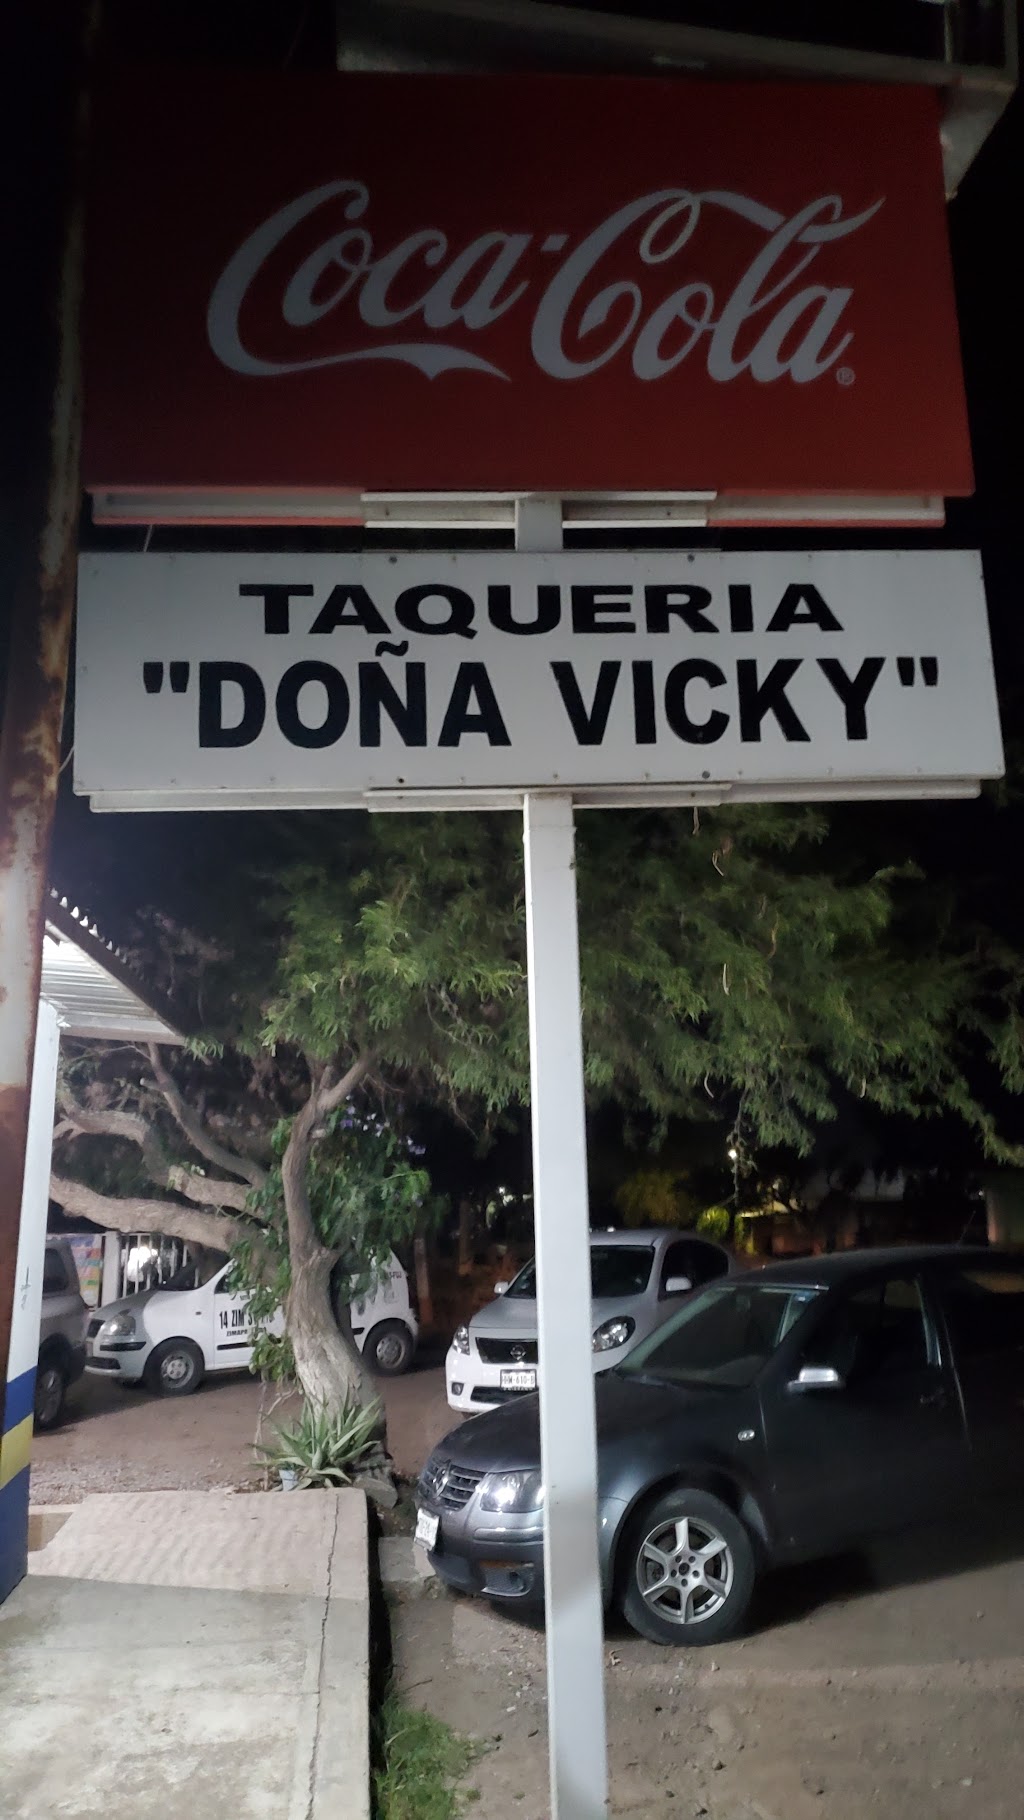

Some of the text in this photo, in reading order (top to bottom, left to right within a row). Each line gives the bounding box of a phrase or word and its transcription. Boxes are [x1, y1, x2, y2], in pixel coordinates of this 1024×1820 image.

[207, 179, 886, 383] Coca-Cola
[239, 582, 844, 640] TAQUERIA
[143, 640, 940, 750] "DOÑA VICKY"
[219, 1310, 228, 1329] 14
[231, 1309, 245, 1327] ZIM
